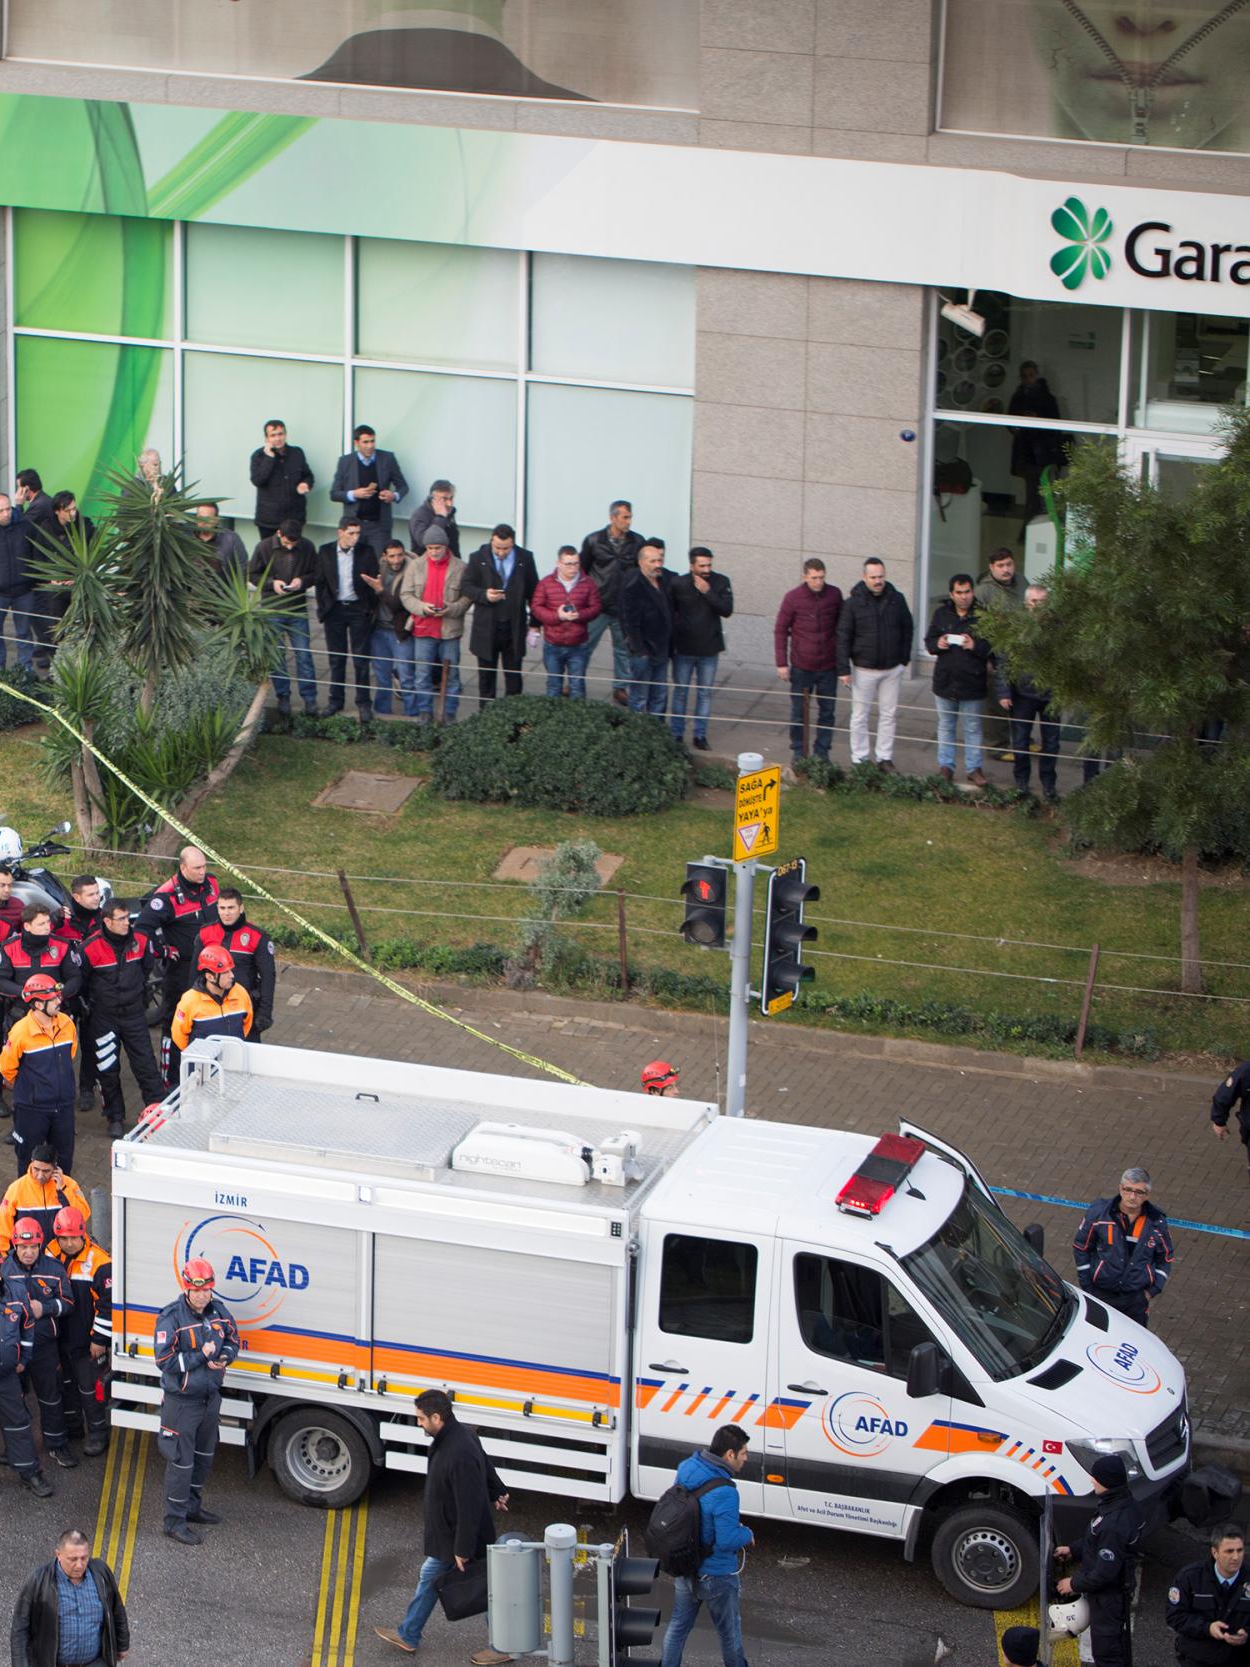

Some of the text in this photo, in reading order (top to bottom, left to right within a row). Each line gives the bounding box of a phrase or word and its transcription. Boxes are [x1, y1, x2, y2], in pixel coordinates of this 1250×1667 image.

[740, 779, 762, 793] SAĞA
[214, 1190, 248, 1208] İZMİR
[225, 1255, 310, 1290] AFAD
[1113, 1342, 1139, 1371] AFAD
[855, 1415, 909, 1437] AFAD
